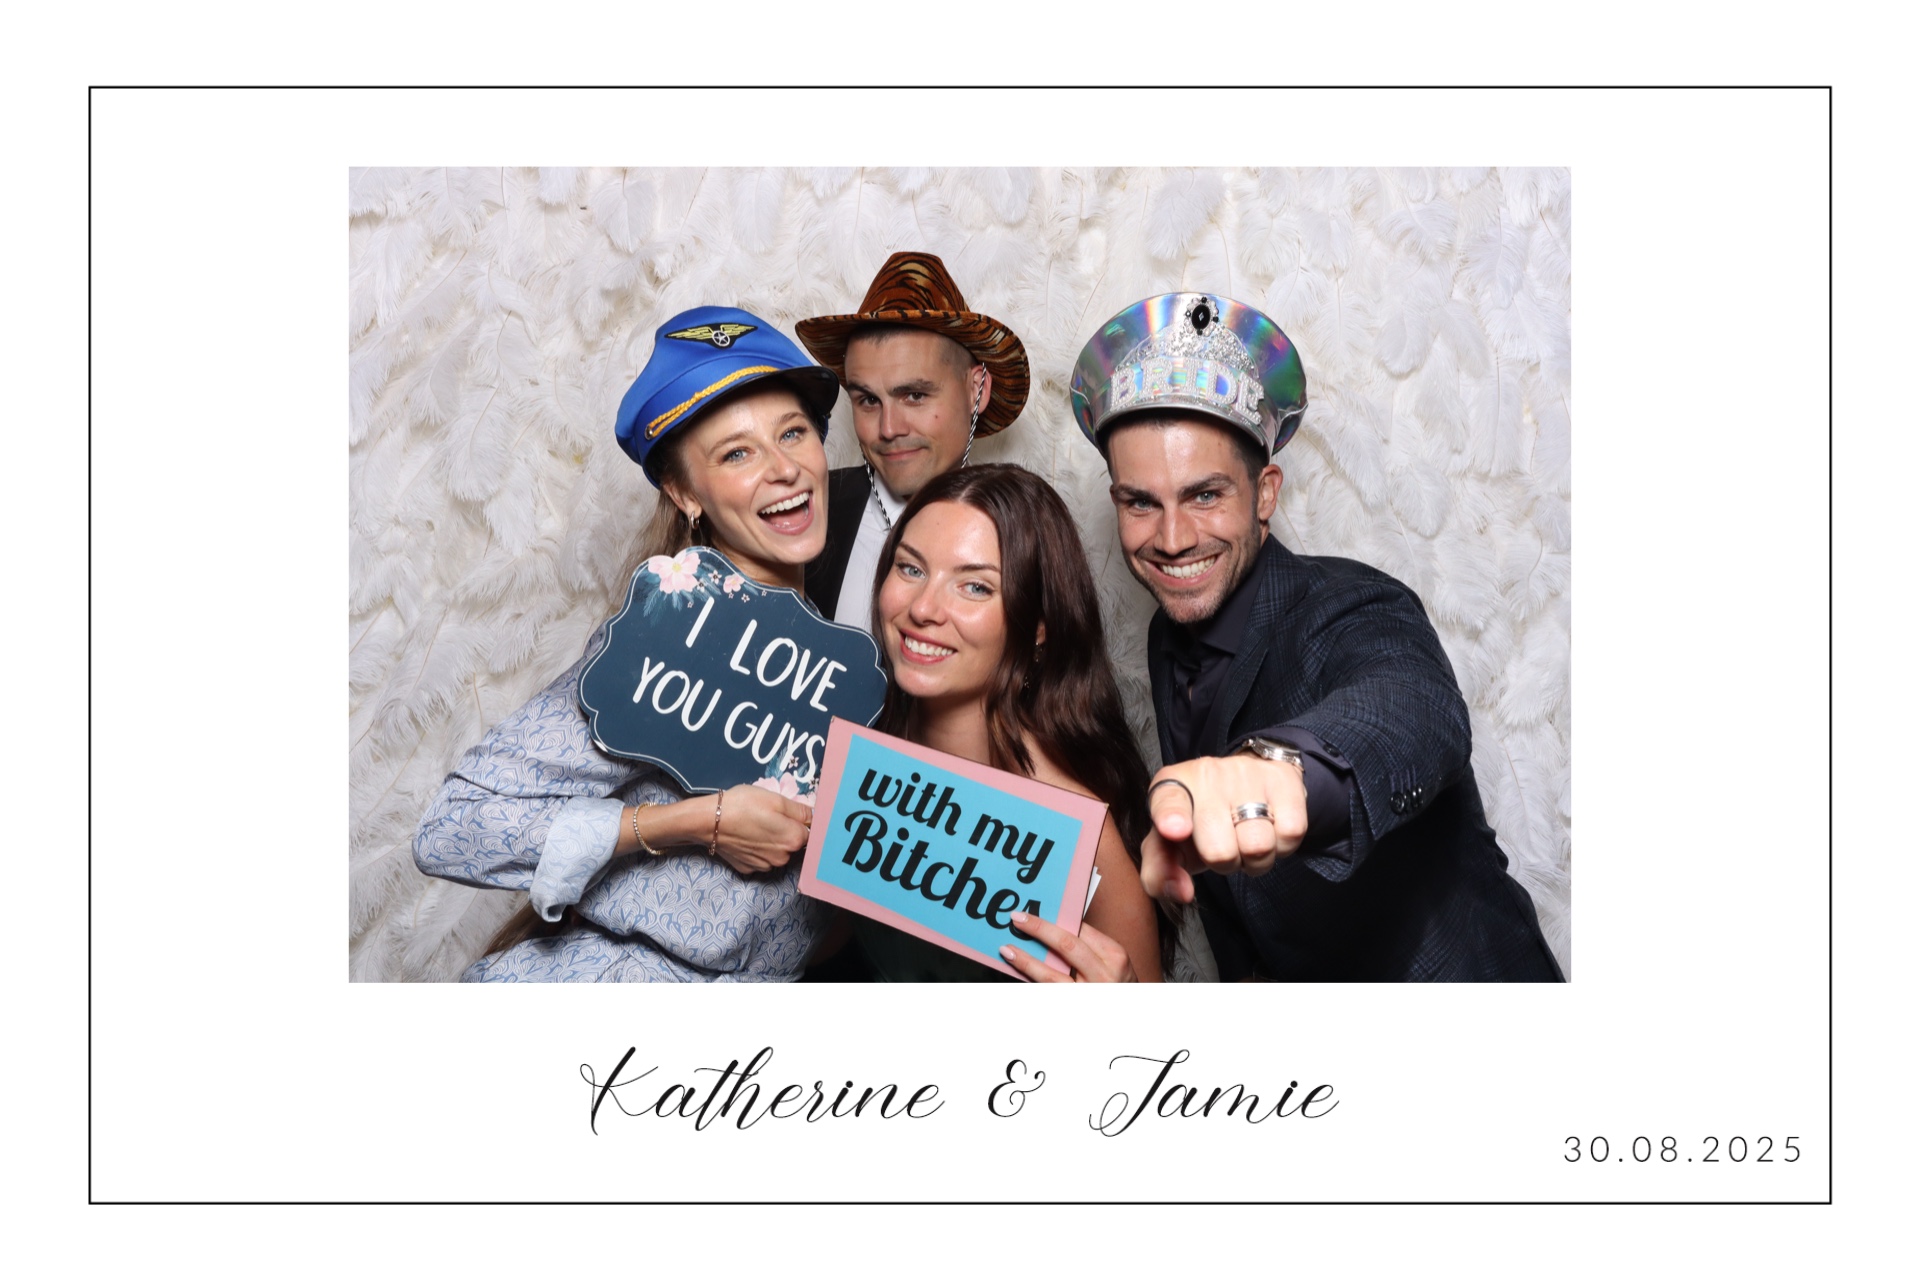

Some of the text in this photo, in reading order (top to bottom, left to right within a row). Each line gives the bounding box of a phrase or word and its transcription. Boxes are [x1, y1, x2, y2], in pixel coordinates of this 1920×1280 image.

[1110, 356, 1265, 425] BRIDE
[685, 596, 848, 712] I LOVE
[632, 656, 826, 783] YOU GUYS
[857, 768, 1055, 884] with my
